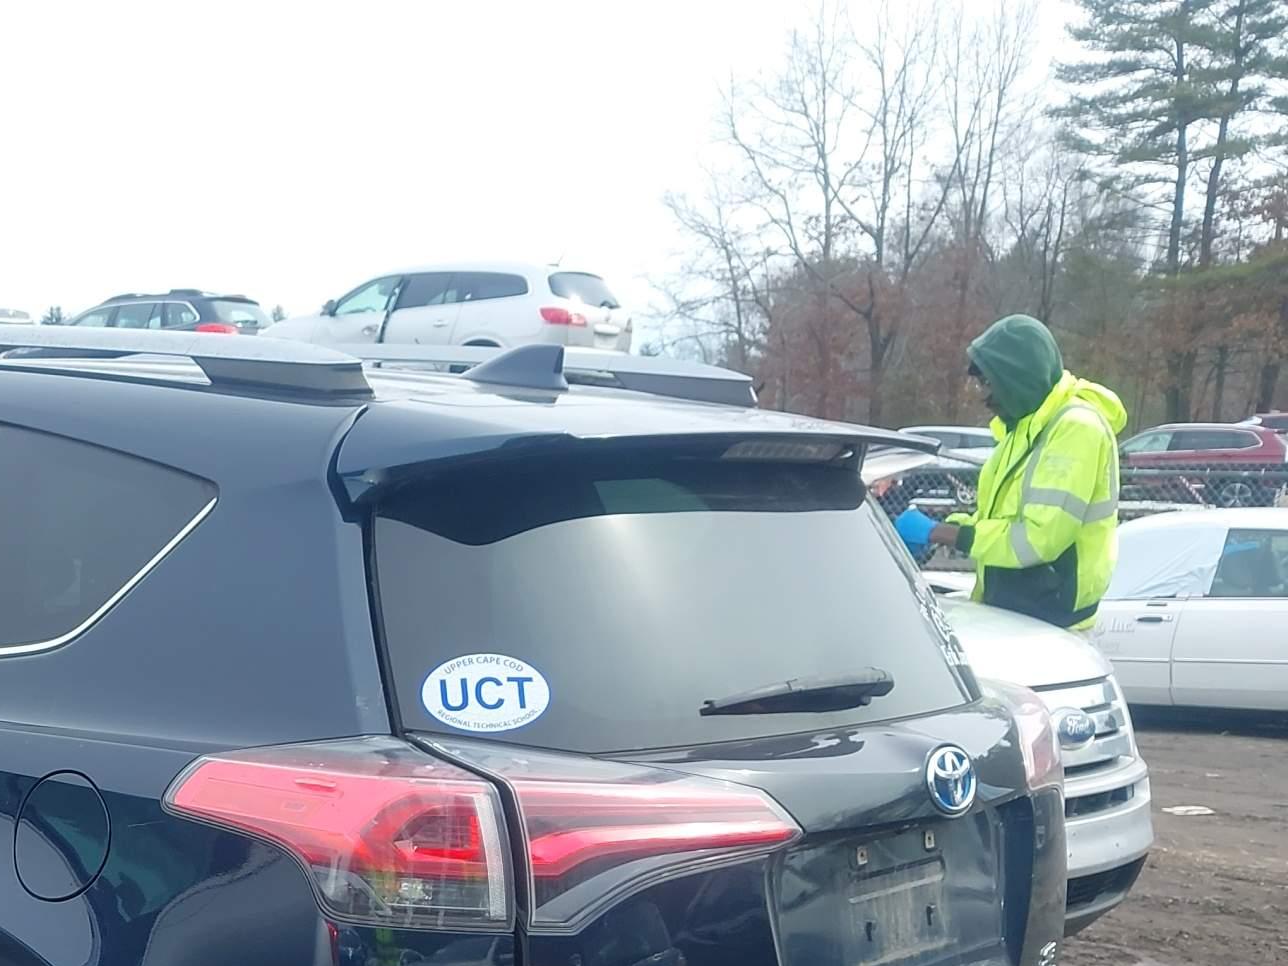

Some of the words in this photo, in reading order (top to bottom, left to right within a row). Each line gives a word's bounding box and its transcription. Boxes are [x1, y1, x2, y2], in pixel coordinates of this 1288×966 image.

[444, 657, 474, 674] UPPER
[475, 655, 502, 666] CAPE
[502, 658, 525, 673] COD
[439, 677, 533, 711] UCT
[437, 709, 471, 728] REGIONAL
[473, 721, 511, 729] TECHNICAL
[512, 708, 539, 726] SCHOOL
